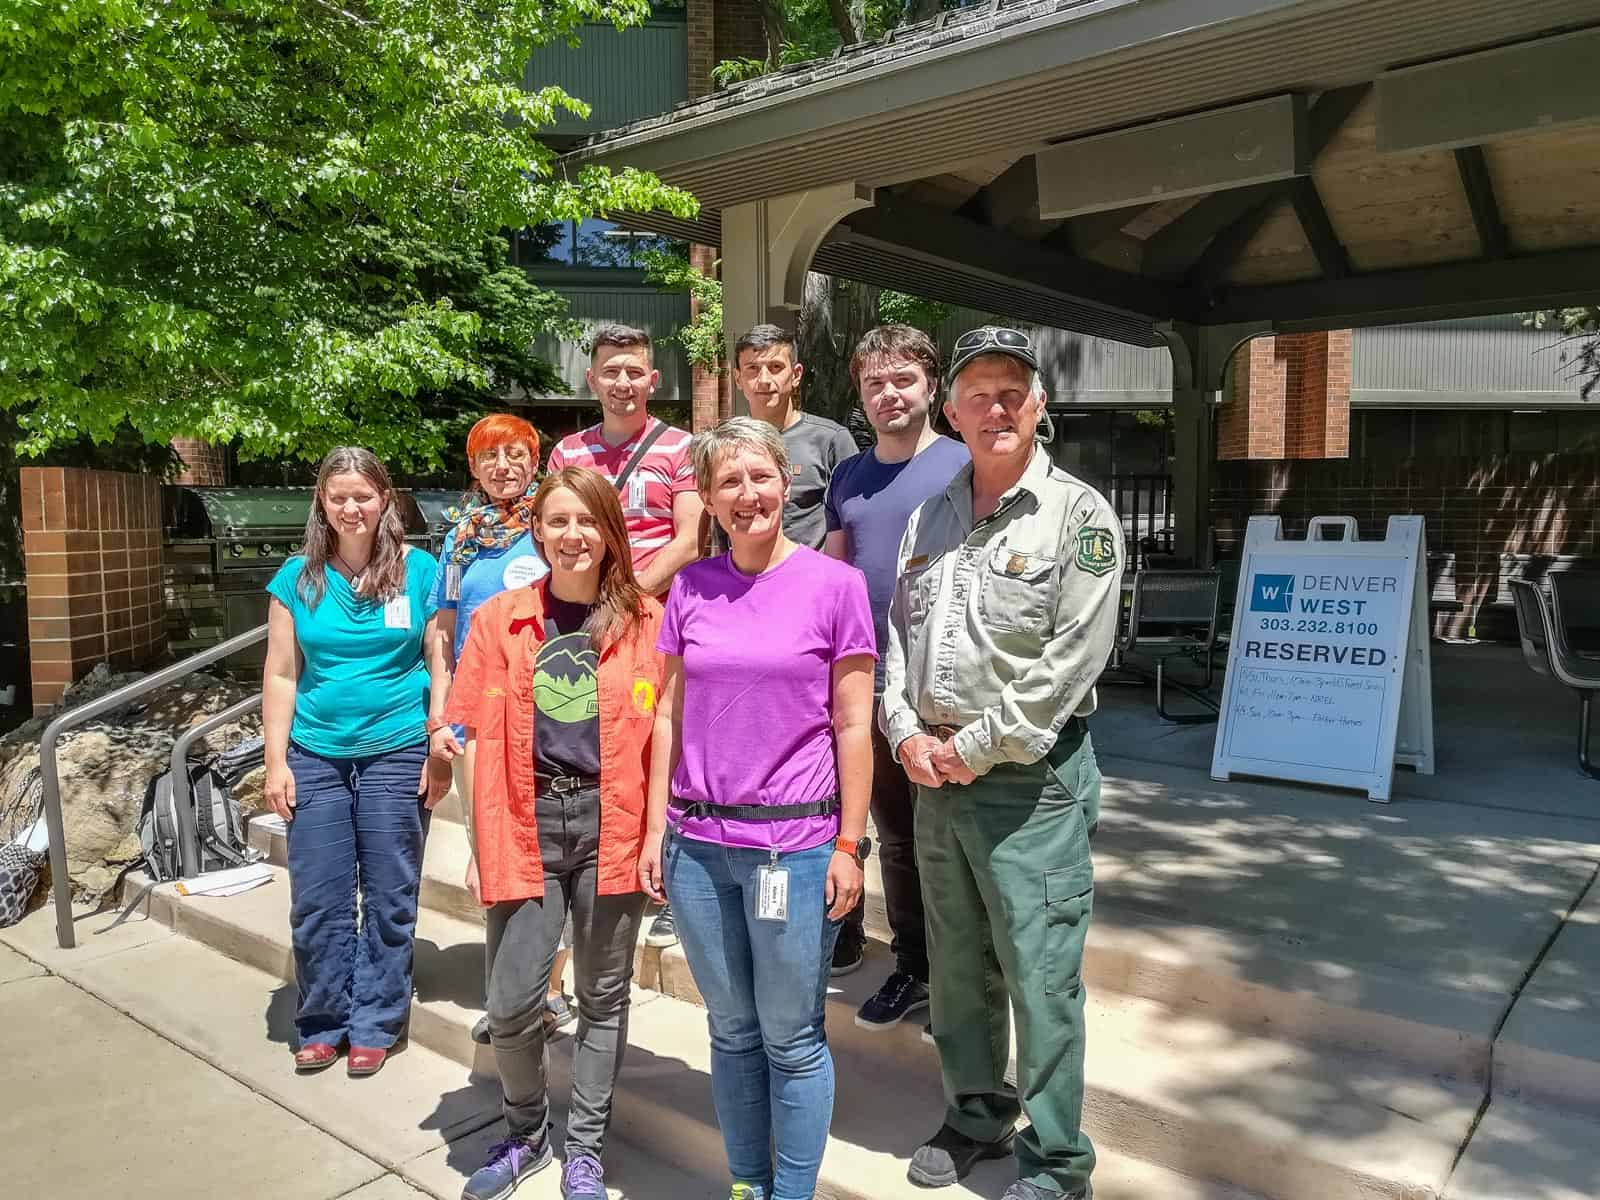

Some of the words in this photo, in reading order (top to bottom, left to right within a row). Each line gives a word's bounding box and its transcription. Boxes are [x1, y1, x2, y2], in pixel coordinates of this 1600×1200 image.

[1303, 575, 1398, 592] DENVER
[1262, 585, 1280, 601] W
[1300, 599, 1367, 616] WEST
[1260, 618, 1378, 635] 303.232.8100
[1245, 640, 1387, 667] RESERVED
